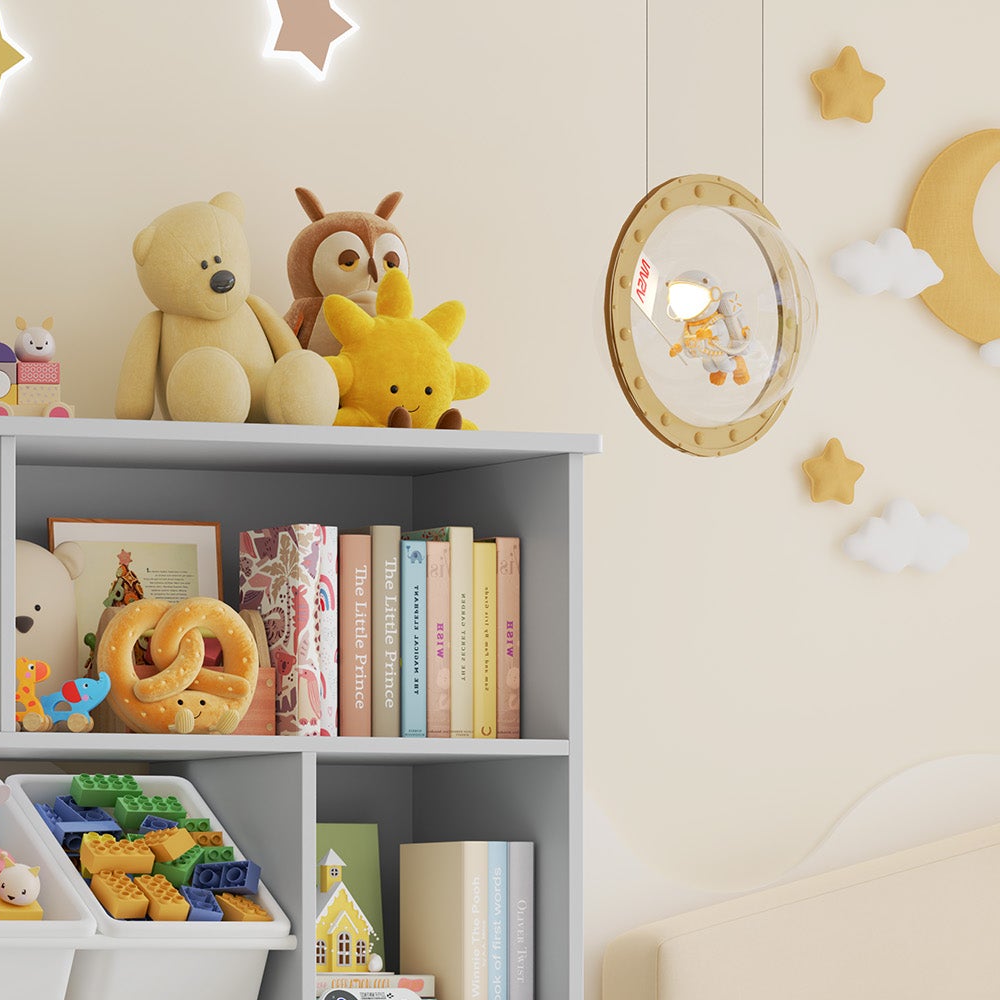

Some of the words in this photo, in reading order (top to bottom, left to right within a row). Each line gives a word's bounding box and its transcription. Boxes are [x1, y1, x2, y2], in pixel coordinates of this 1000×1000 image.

[355, 565, 368, 597] The
[384, 557, 397, 590] The
[355, 601, 368, 649] Little
[384, 595, 397, 645] Little
[354, 654, 368, 709] Prince
[384, 650, 397, 709] Prince
[472, 876, 481, 914] Pooh
[492, 866, 502, 916] words
[472, 917, 481, 945] The
[492, 919, 502, 951] first
[472, 948, 481, 998] Winnie
[492, 953, 502, 971] of
